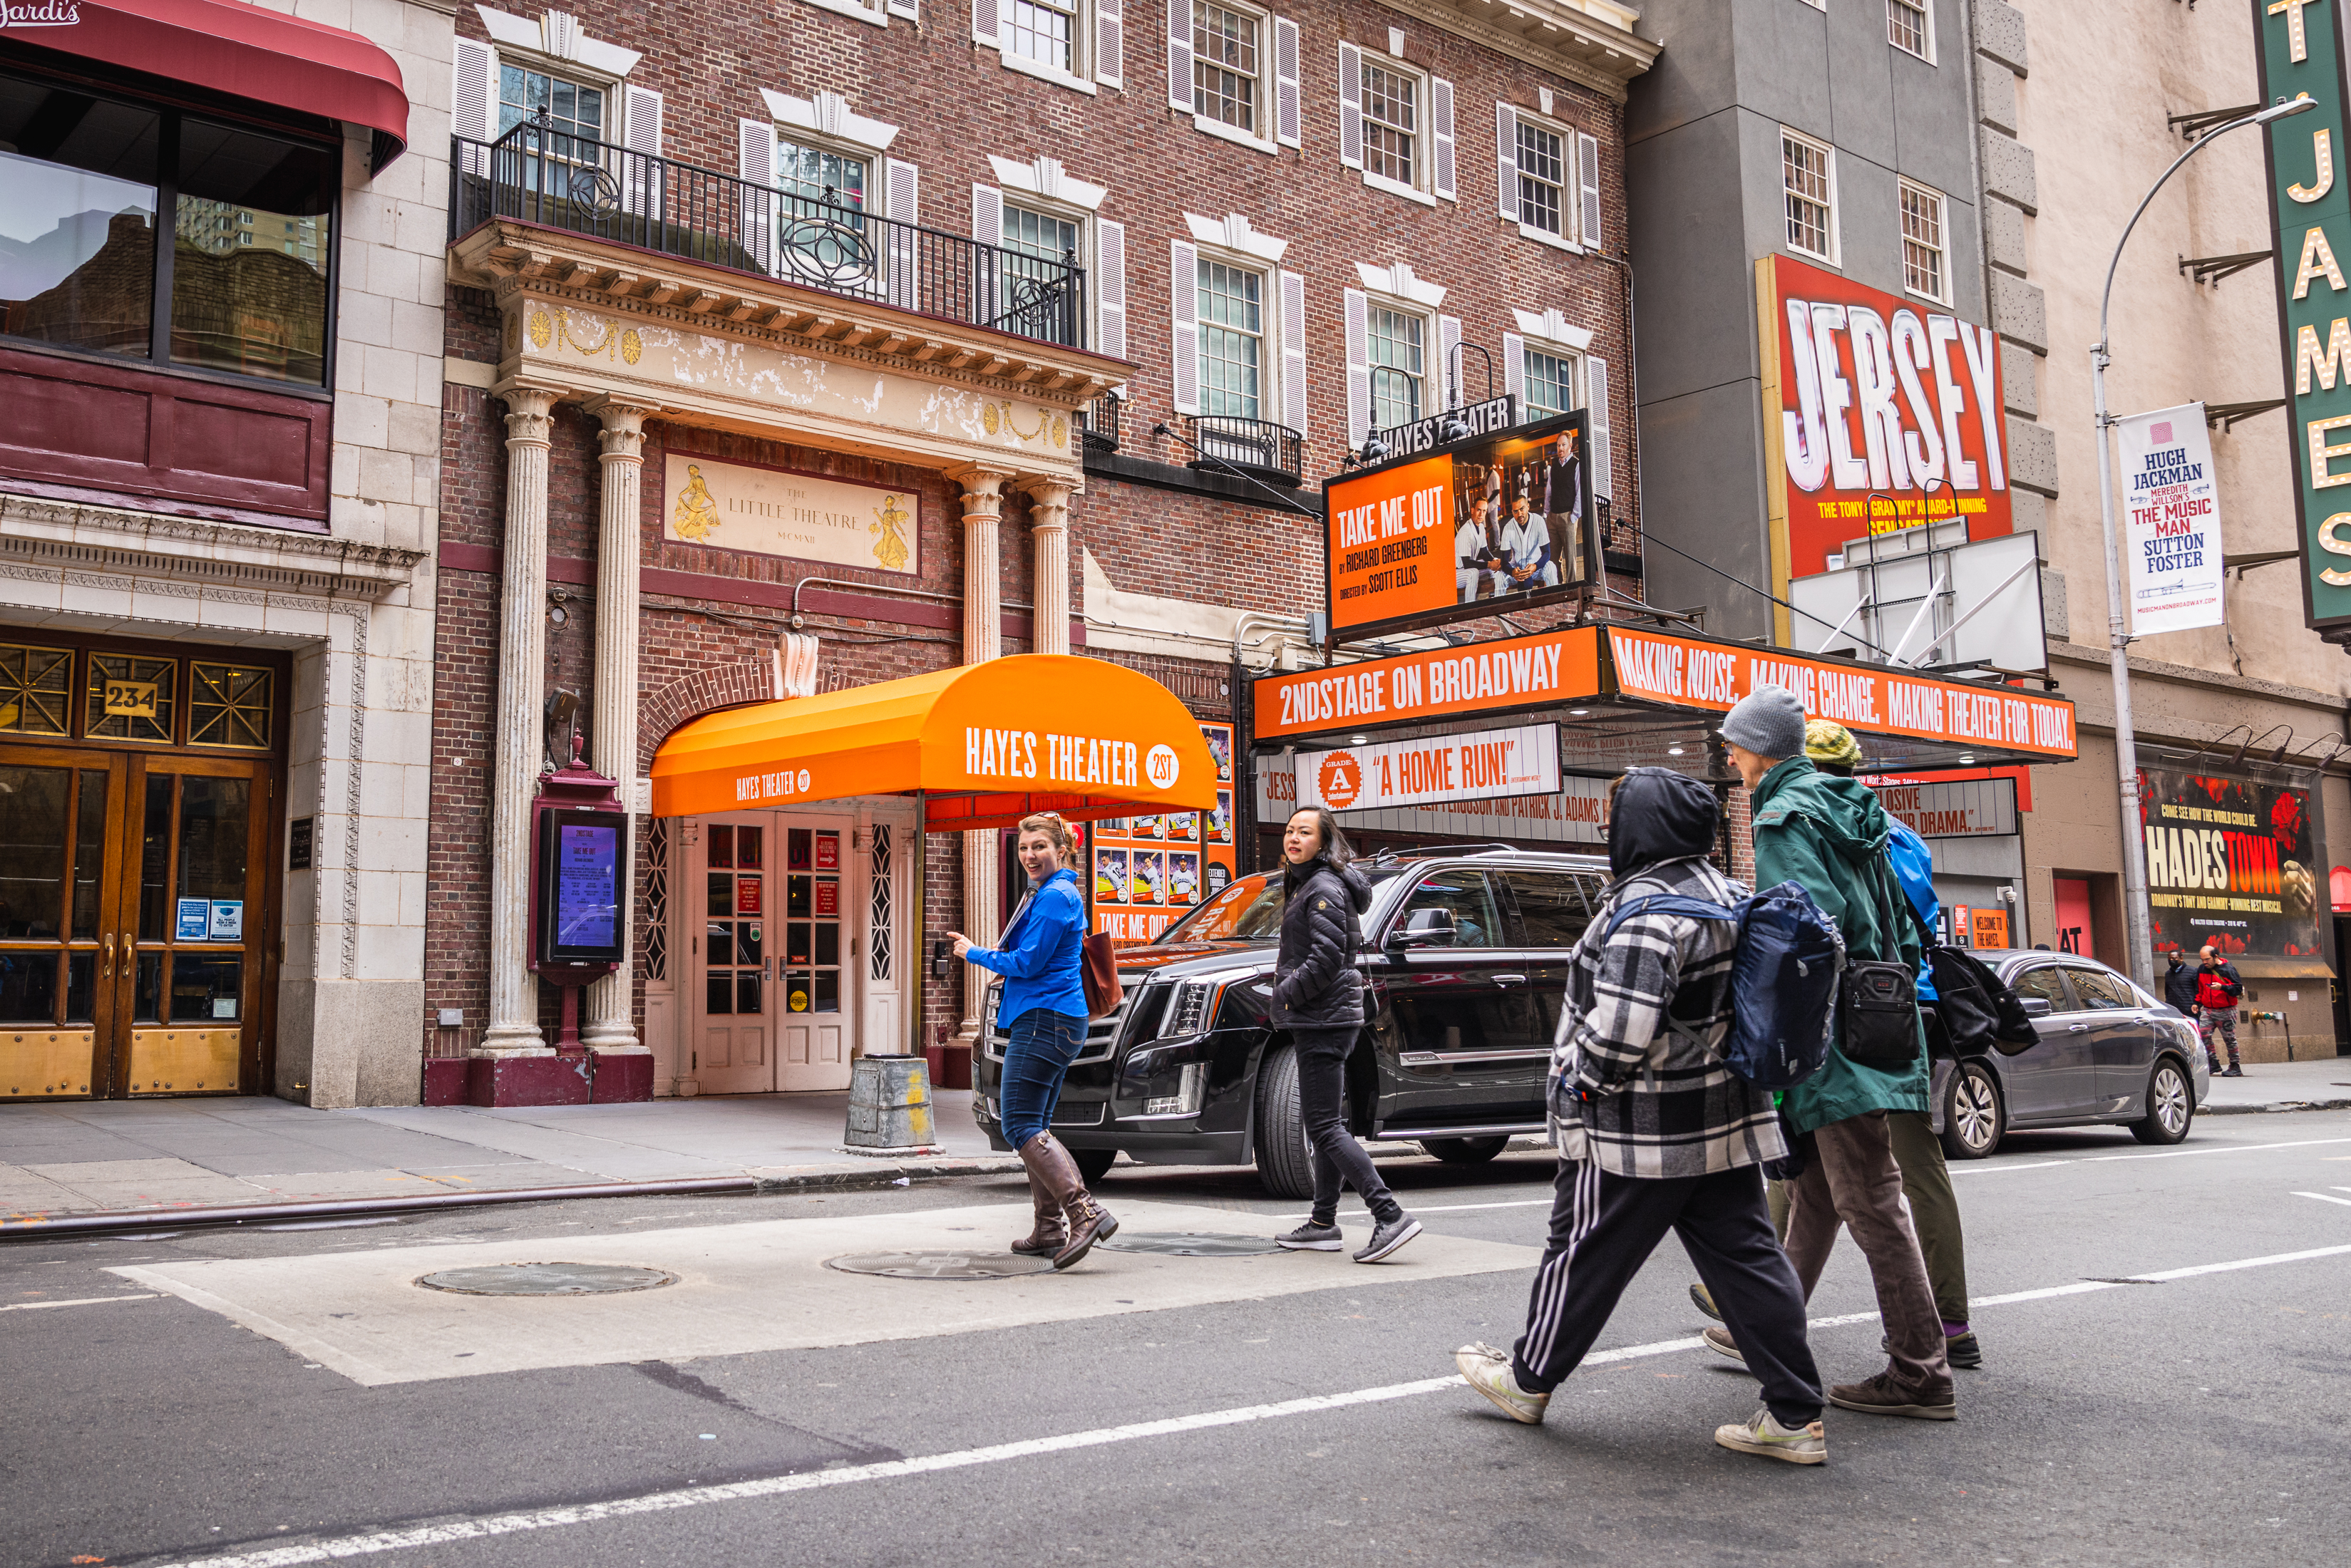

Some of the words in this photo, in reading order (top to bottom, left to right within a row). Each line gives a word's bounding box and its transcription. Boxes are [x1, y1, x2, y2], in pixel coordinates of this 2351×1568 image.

[1783, 298, 2005, 492] JERSEY
[1383, 419, 1434, 460] HAYES
[1435, 398, 1508, 445] TEATER
[2145, 448, 2186, 470] HUGH
[2134, 463, 2202, 490] JACKMAN
[787, 488, 807, 499] THE
[2151, 484, 2188, 497] MEREDITH
[2151, 492, 2190, 506] WILLSON'S
[729, 497, 786, 519] LITTLE
[792, 507, 860, 530] THEATRE
[1337, 503, 1377, 548] TAKE
[1380, 495, 1407, 538] ME
[1412, 485, 1444, 530] OUT
[1818, 502, 1838, 519] THE
[1838, 501, 1863, 517] TONY
[2131, 507, 2161, 525] THE
[2164, 498, 2212, 520] MUSIC
[2155, 518, 2191, 538] MAN
[1339, 563, 1345, 574] BY
[1346, 547, 1379, 572] RICHARD
[1382, 535, 1427, 564] GREENBERG
[2144, 533, 2204, 557] SUTTON
[2147, 551, 2203, 573] FOSTER
[1340, 585, 1360, 600] DIRECTED
[1362, 584, 1367, 595] BY
[1369, 569, 1394, 594] SCOTT
[1396, 564, 1418, 588] ELLIS
[2137, 597, 2216, 614] MUSICMANONBROADWAY.COM
[1280, 670, 1386, 726] 2NDSTAGE
[1392, 664, 1422, 710] ON
[1429, 643, 1562, 705] BROADWAY
[1615, 636, 1683, 697] MAKING
[1687, 648, 1739, 704] NOISE.
[1818, 669, 1880, 725] CHANGE.
[1888, 681, 1943, 733] MAKING
[1946, 689, 2002, 741] THEATER
[2004, 698, 2030, 744] FOR
[2030, 703, 2074, 751] TODAY.
[108, 687, 155, 710] 234
[966, 727, 1037, 778] HAYES
[1046, 733, 1138, 787] THEATER
[1153, 753, 1172, 780] 2ST
[1326, 759, 1352, 768] GRADE:
[1399, 748, 1453, 795] HOME
[1461, 740, 1514, 789] RUN!"
[736, 775, 759, 801] HAYES
[762, 770, 794, 798] THEATER
[1329, 768, 1352, 790] A
[1262, 771, 1295, 802] "JESS
[1495, 798, 1509, 816] AND
[1512, 795, 1550, 820] PATRICK
[1553, 794, 1562, 821] J.
[1565, 796, 1599, 823] ADAMS
[1327, 791, 1353, 801] Entertainment
[1873, 788, 1921, 811] LOSIVE
[1920, 809, 1974, 835] DRAMA."
[2161, 804, 2178, 819] COME
[2178, 805, 2188, 820] SEE
[2188, 806, 2201, 821] HOW
[2202, 808, 2213, 822] THE
[2213, 810, 2231, 825] WORLD
[2232, 812, 2248, 826] COULD
[2248, 814, 2258, 827] BE.
[2146, 825, 2280, 894] HADESTOWN
[1112, 867, 1123, 879] 18
[1208, 868, 1225, 878] EXTENDED
[1209, 877, 1225, 887] THROUGH
[2151, 893, 2183, 908] BROADWAY'S
[2196, 896, 2206, 909] AND
[2250, 899, 2262, 912] BEST
[1099, 913, 1126, 939] TAKE
[1128, 914, 1146, 939] ME
[1148, 914, 1169, 940] OUT
[1975, 916, 1996, 931] WELCOME
[1996, 917, 2002, 931] TO
[2057, 927, 2082, 955] AT
